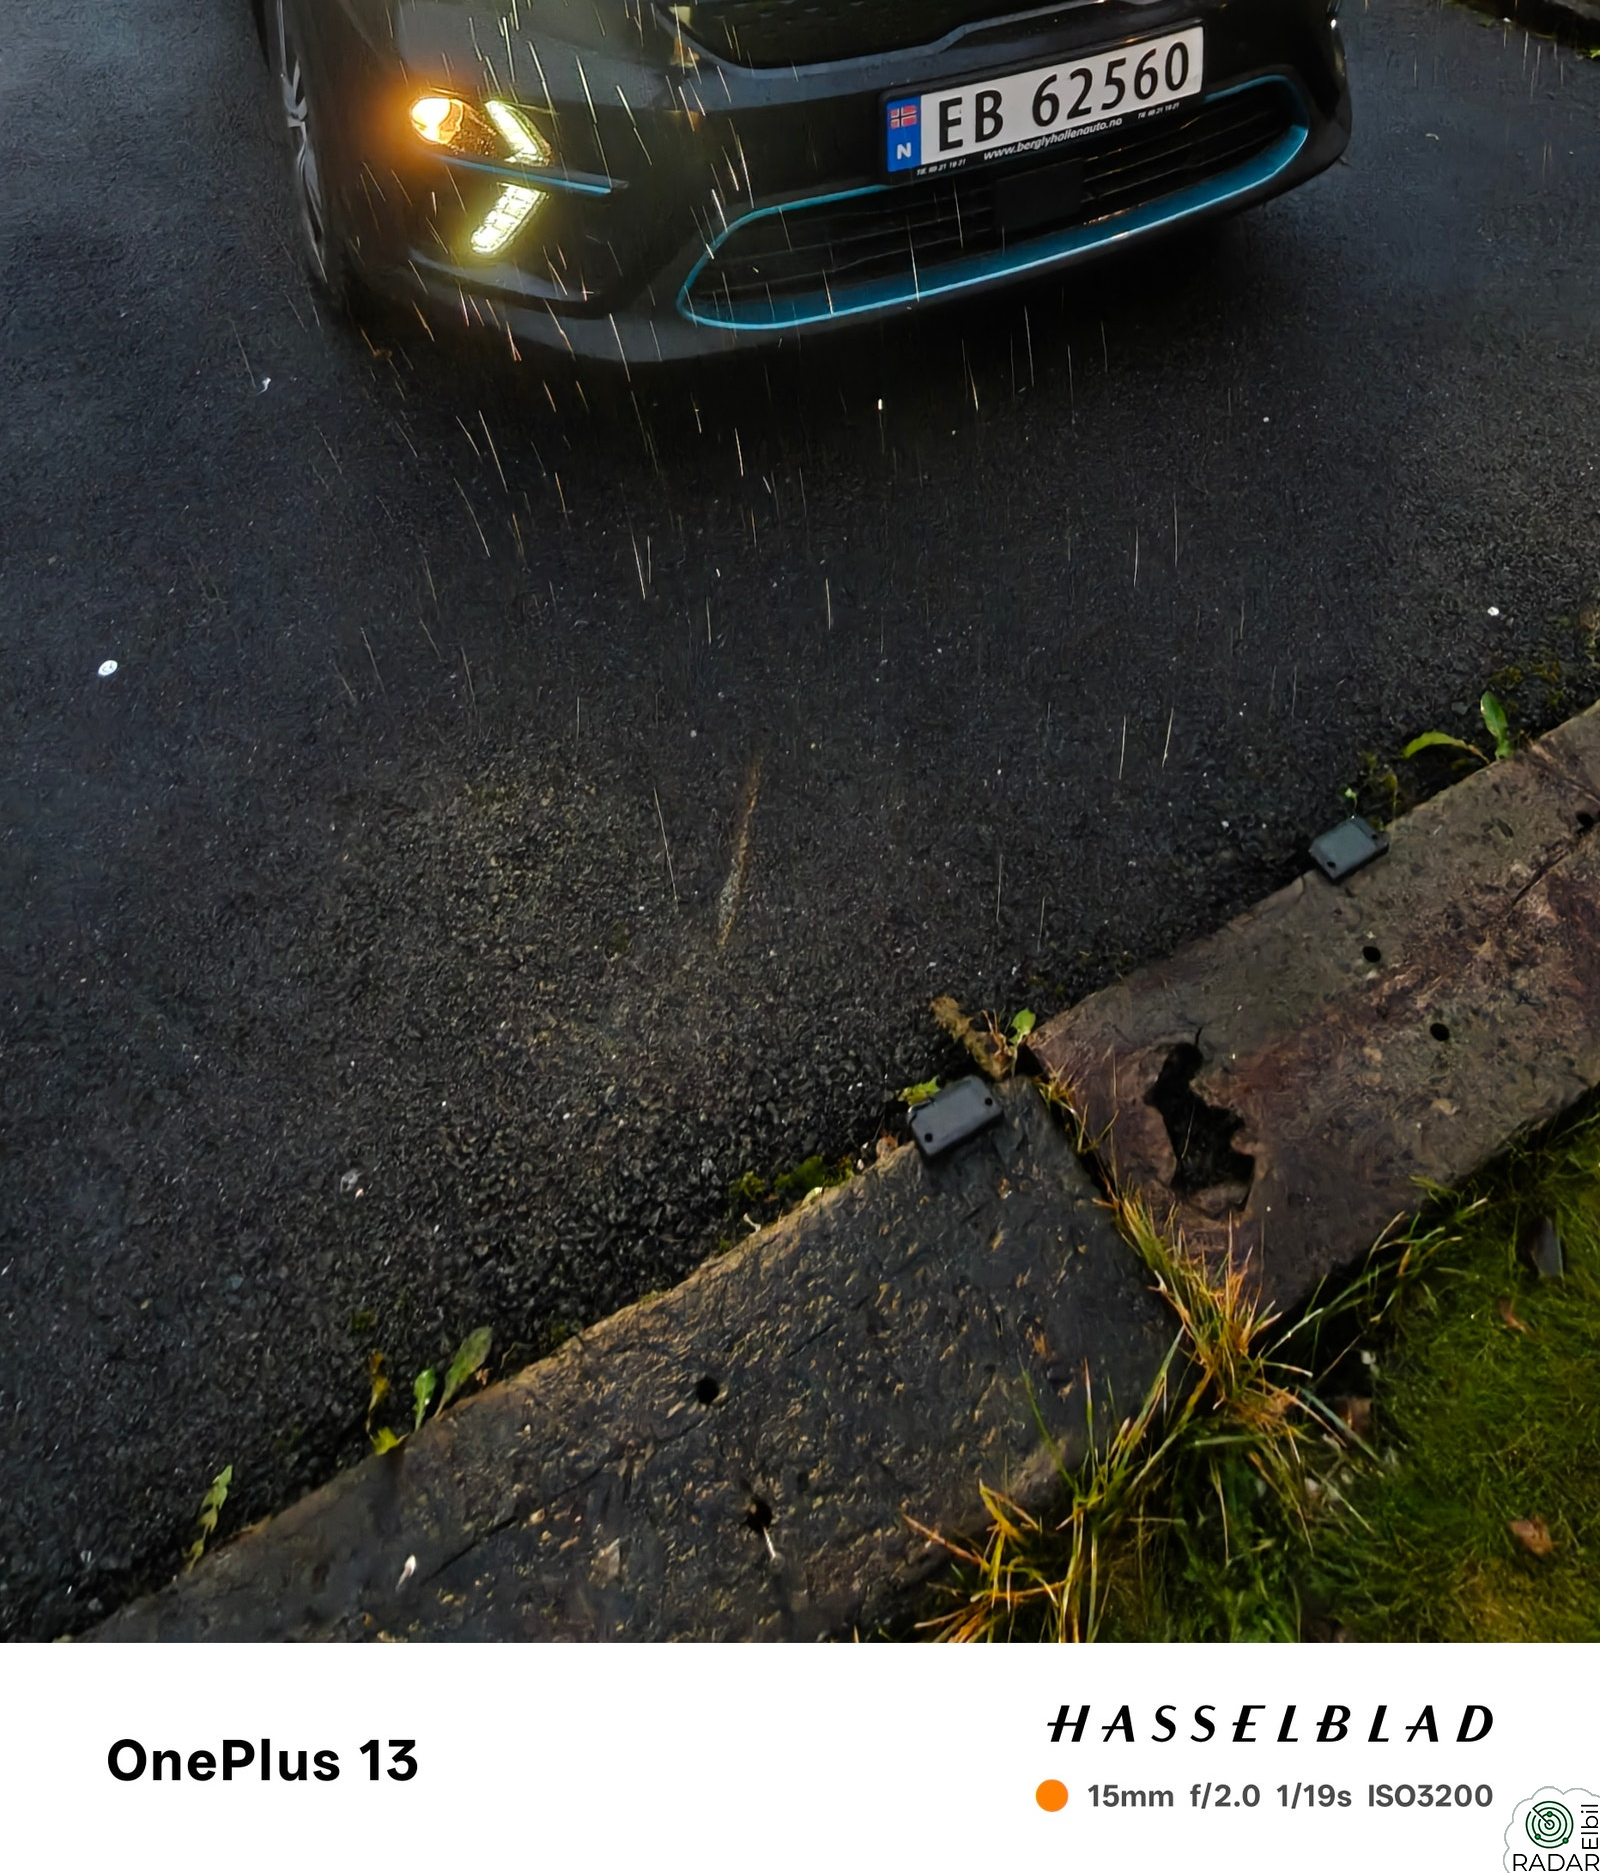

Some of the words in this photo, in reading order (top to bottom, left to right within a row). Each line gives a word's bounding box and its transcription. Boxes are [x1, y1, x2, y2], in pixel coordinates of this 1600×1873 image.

[939, 89, 1004, 152] EB
[1031, 41, 1189, 127] 62560
[896, 142, 912, 160] N
